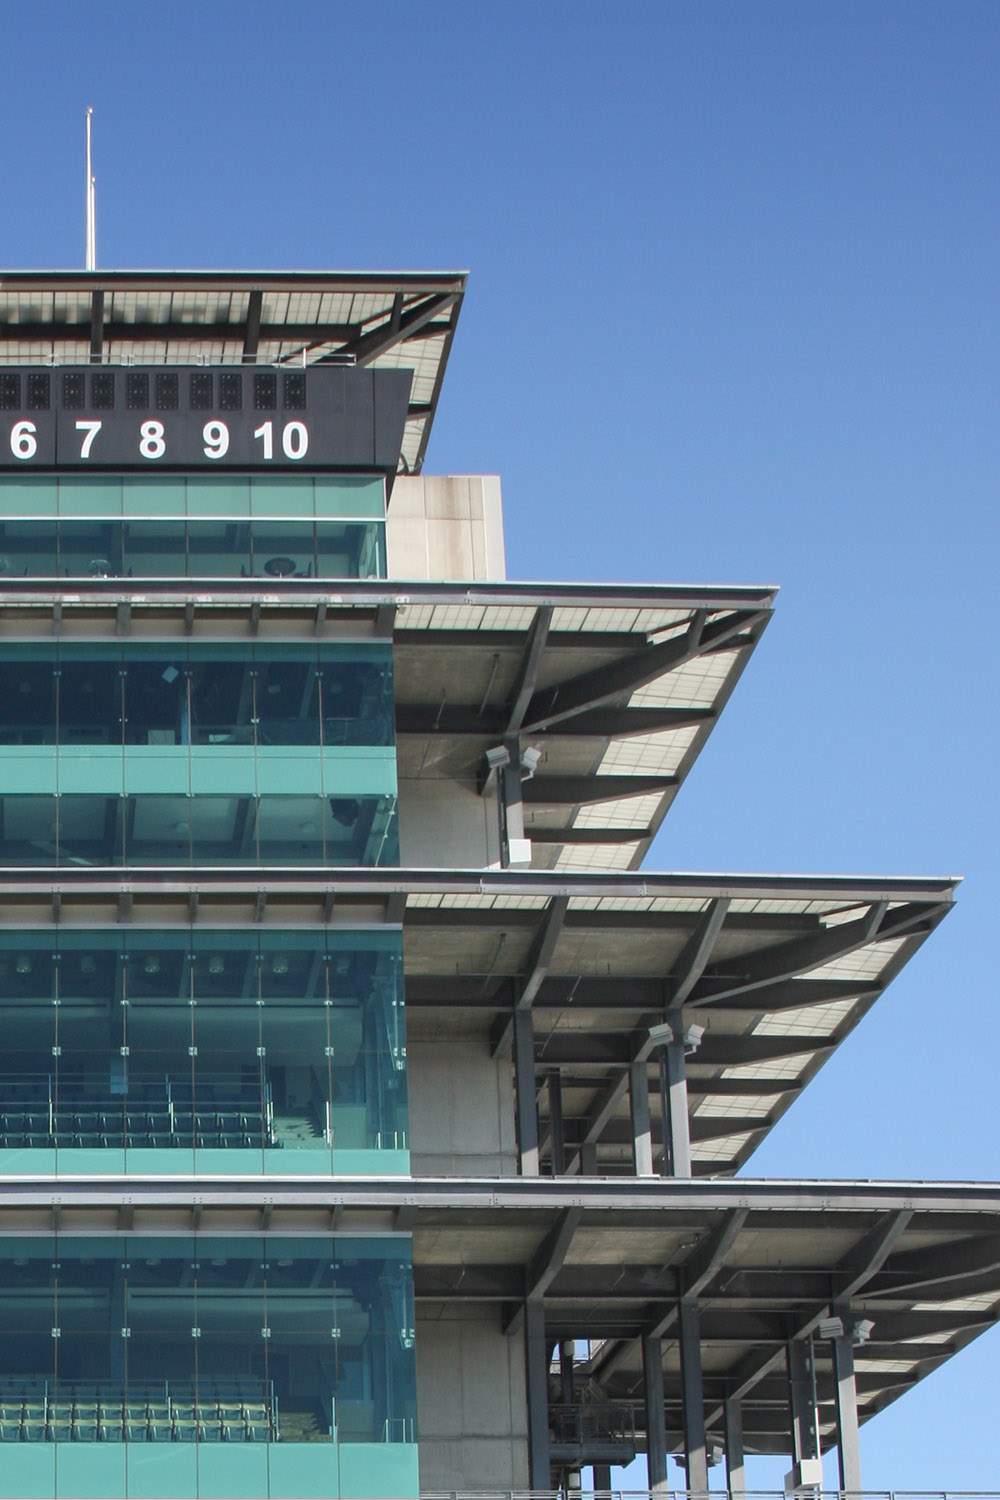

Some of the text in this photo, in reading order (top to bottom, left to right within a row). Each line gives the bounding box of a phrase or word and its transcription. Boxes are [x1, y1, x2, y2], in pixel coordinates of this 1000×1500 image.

[10, 421, 38, 460] 6
[76, 421, 102, 459] 7
[139, 421, 166, 460] 8
[202, 421, 230, 460] 9
[254, 421, 309, 460] 10
